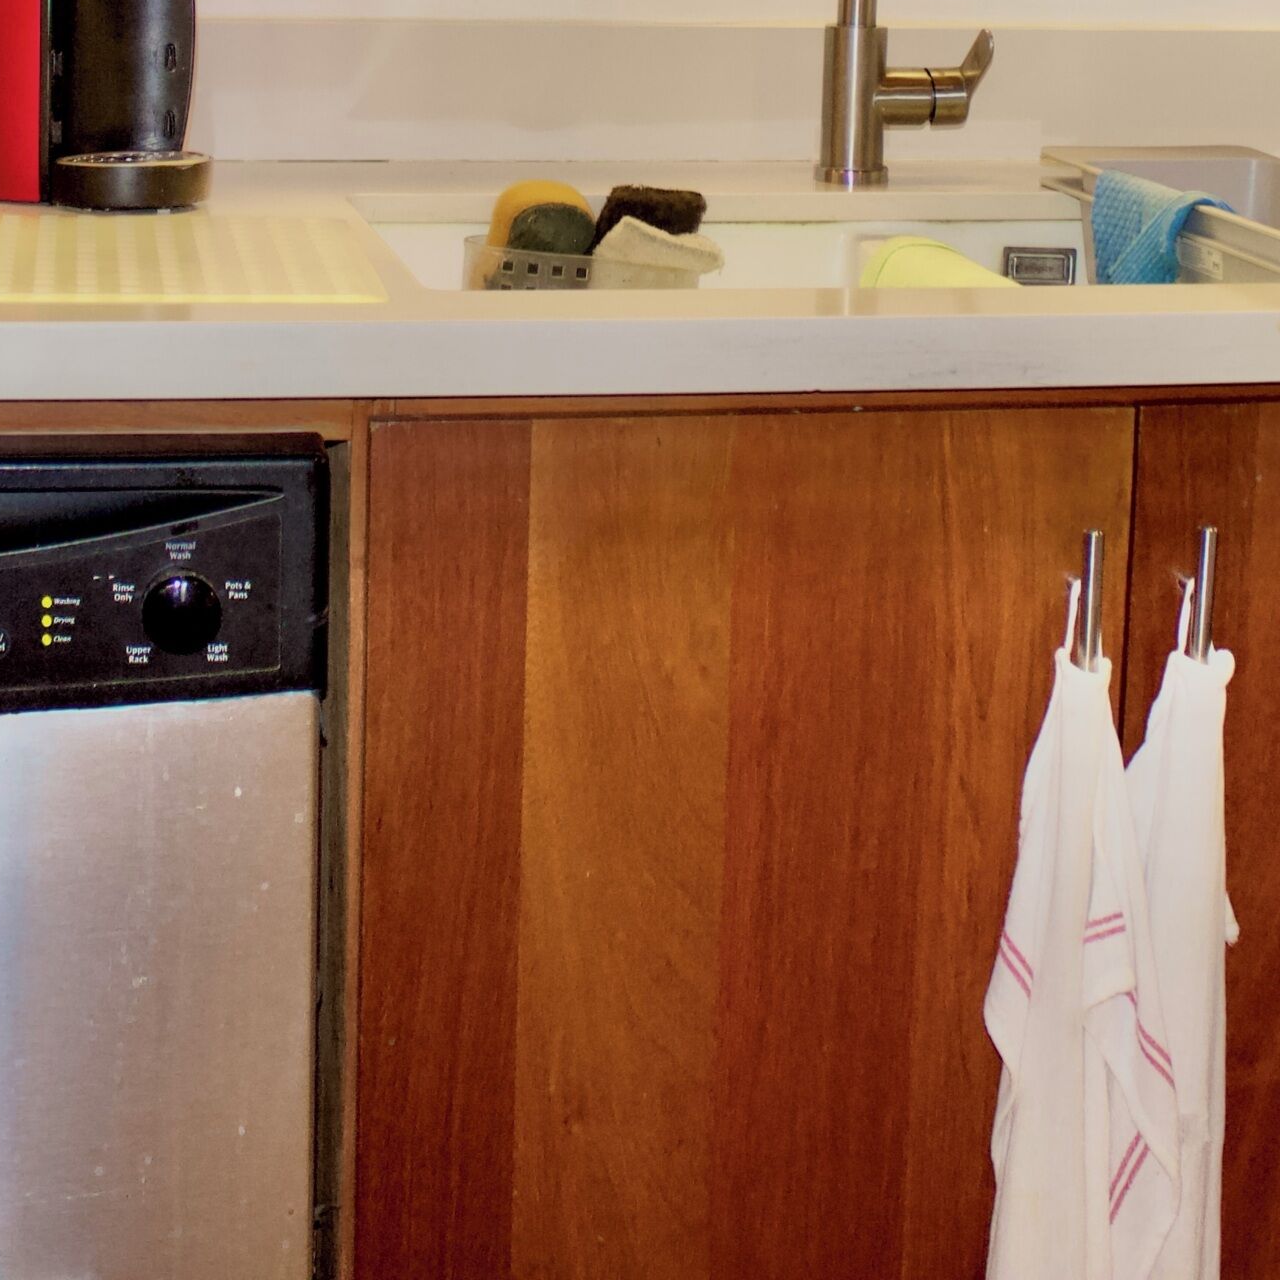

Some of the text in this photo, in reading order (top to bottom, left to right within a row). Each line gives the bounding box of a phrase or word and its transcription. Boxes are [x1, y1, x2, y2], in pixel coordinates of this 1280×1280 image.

[165, 542, 196, 551] Normal
[170, 551, 191, 560] Wash
[112, 583, 135, 593] Rinse
[225, 581, 251, 590] Pots &
[114, 593, 133, 603] Only
[228, 591, 248, 600] Pans
[54, 597, 80, 606] Washing
[53, 616, 75, 625] Drying
[125, 645, 151, 656] Upper
[207, 644, 228, 654] Light
[128, 654, 149, 664] Rack
[207, 653, 229, 662] Wash
